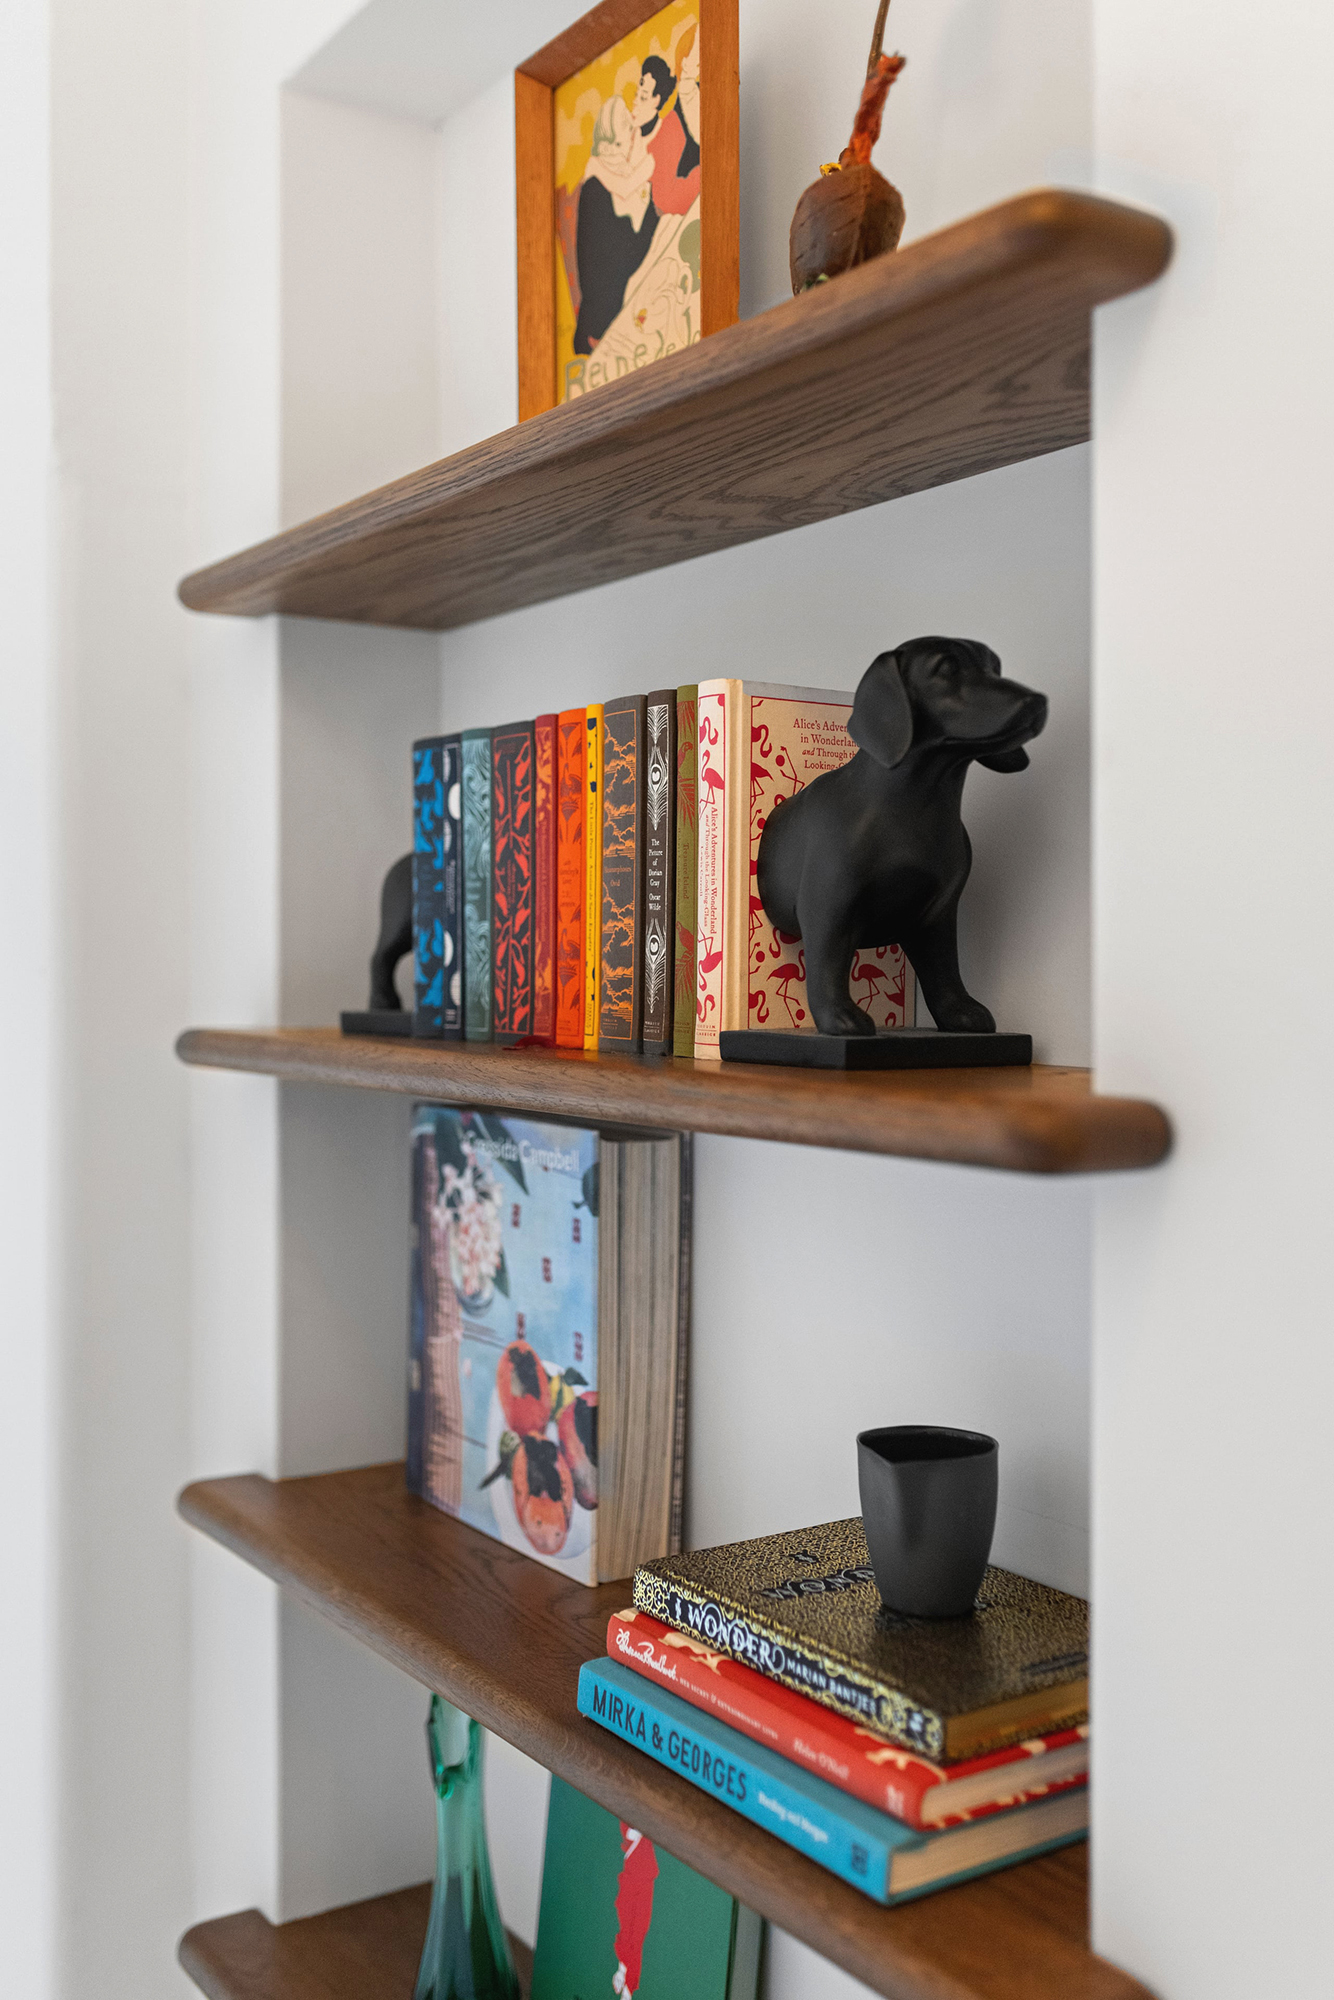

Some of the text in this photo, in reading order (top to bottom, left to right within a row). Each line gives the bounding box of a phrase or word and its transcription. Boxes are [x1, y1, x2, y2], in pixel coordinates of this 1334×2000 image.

[565, 343, 647, 400] Reine
[793, 718, 820, 730] Alice's
[800, 733, 859, 748] in Wonderlan
[802, 748, 815, 756] and
[816, 747, 848, 761] Through
[651, 838, 660, 846] The
[652, 858, 658, 866] of
[649, 879, 660, 888] Gray
[711, 878, 717, 886] in
[648, 893, 661, 901] Oscar
[648, 903, 661, 911] Wilde
[710, 887, 718, 934] Wonderland
[519, 1140, 580, 1173] Campbell
[675, 1598, 682, 1621] I
[688, 1603, 786, 1674] WONDER
[787, 1658, 827, 1688] MARIAN
[592, 1685, 647, 1742] MIRKA
[651, 1724, 664, 1752] &
[668, 1730, 748, 1802] GEORGES
